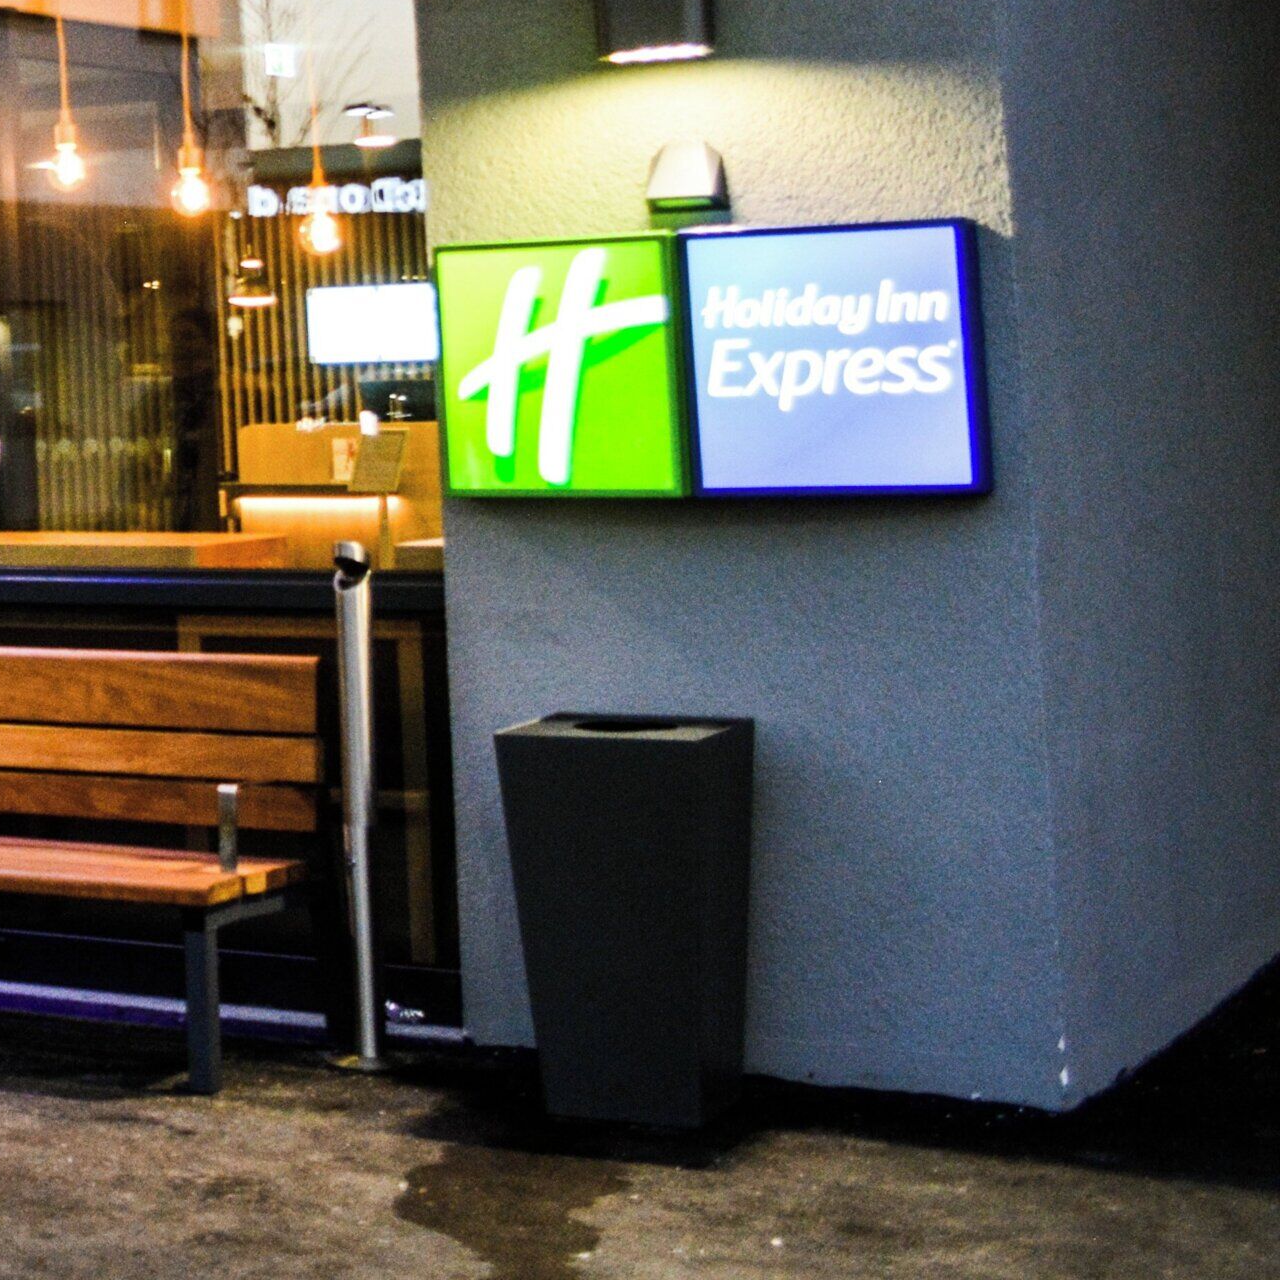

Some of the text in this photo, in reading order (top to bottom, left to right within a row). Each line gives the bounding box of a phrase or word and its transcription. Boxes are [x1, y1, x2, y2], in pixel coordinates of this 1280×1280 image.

[700, 278, 950, 336] Holiday Inn
[706, 336, 955, 413] Express
